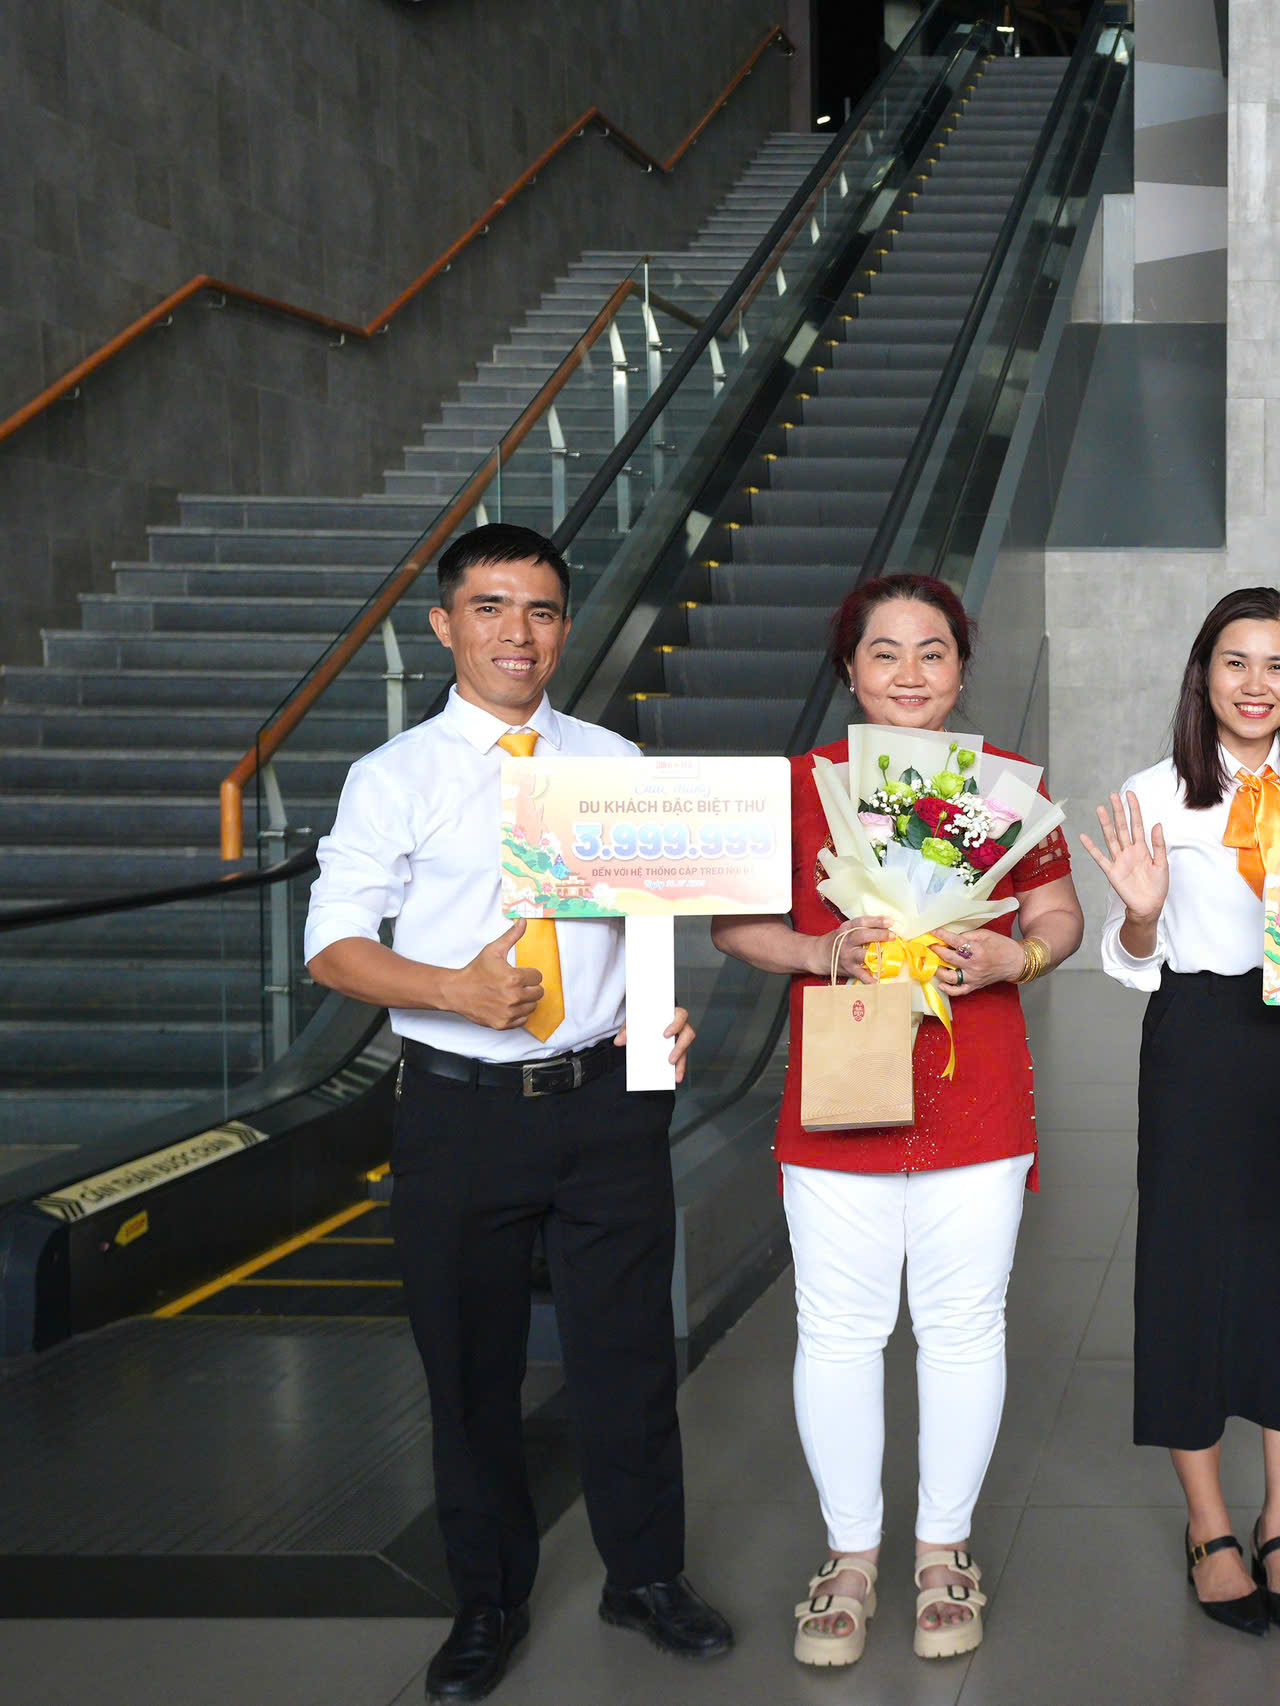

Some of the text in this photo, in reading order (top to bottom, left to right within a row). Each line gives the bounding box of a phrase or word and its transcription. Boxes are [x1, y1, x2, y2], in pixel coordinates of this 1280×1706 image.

[579, 800, 601, 813] DU
[604, 797, 658, 814] KHÁCH
[662, 796, 694, 816] ĐẶC
[697, 796, 729, 816] BIỆT
[573, 822, 775, 860] 3.999.999
[592, 865, 612, 877] ĐẾN
